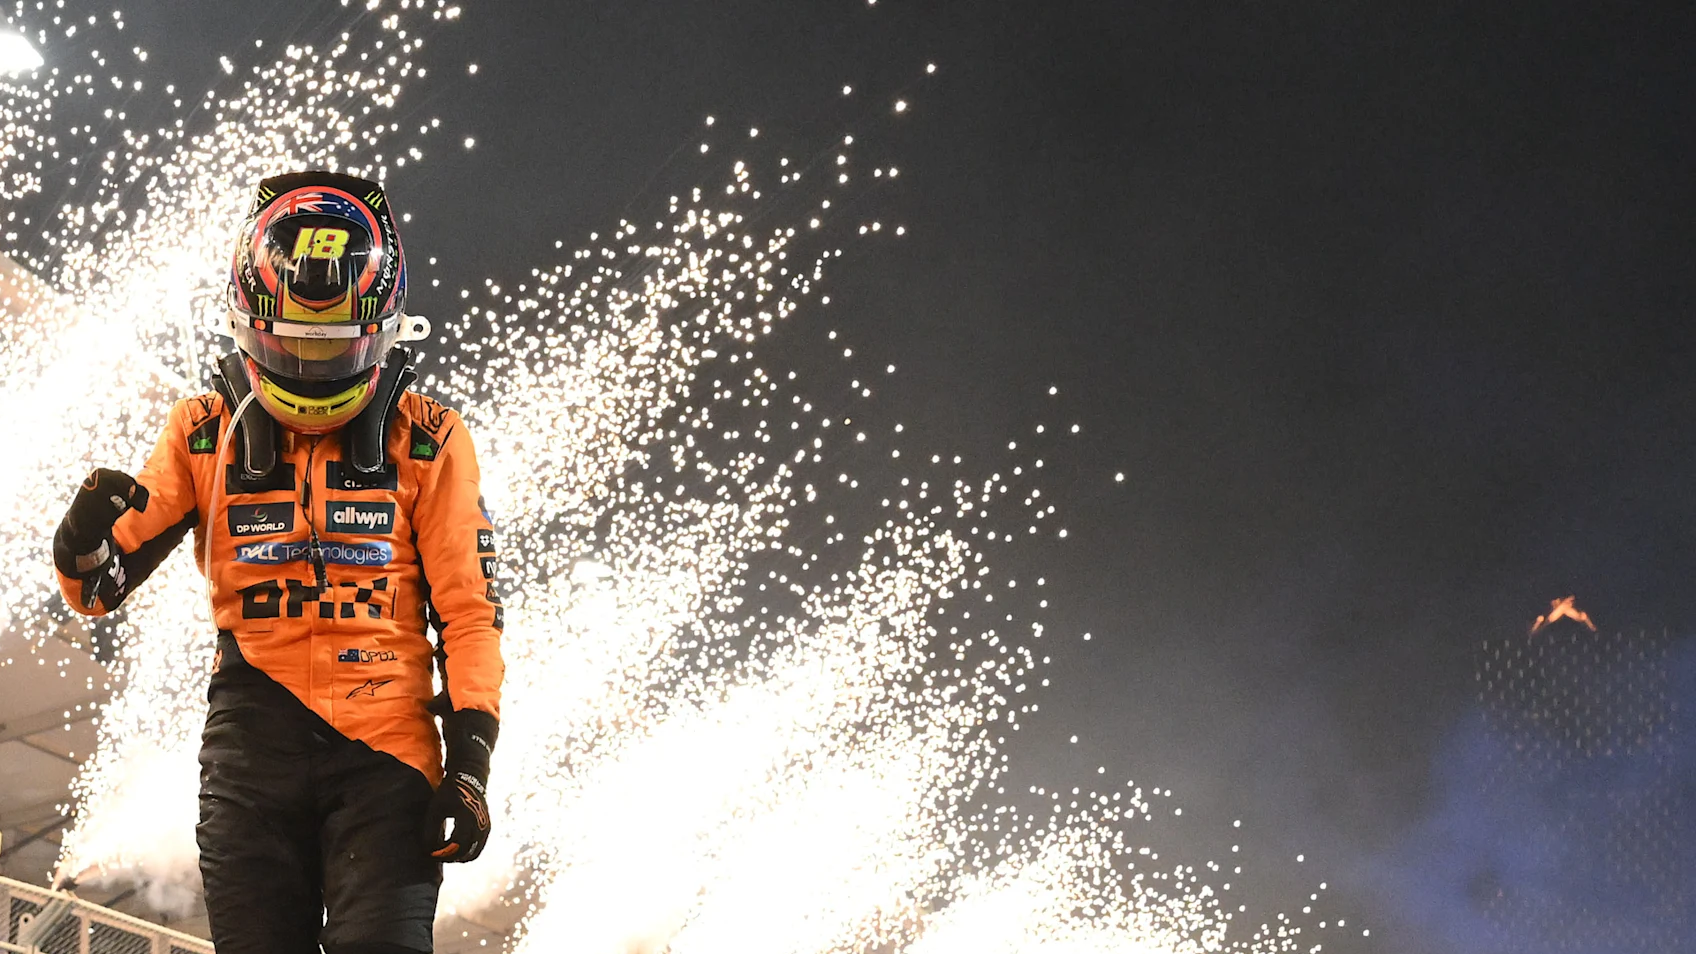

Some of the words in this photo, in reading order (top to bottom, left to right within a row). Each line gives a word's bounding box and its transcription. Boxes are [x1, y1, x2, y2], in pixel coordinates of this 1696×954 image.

[333, 507, 388, 529] allwyn
[236, 525, 252, 533] DP
[252, 522, 285, 532] WORLD
[241, 545, 279, 560] DELL
